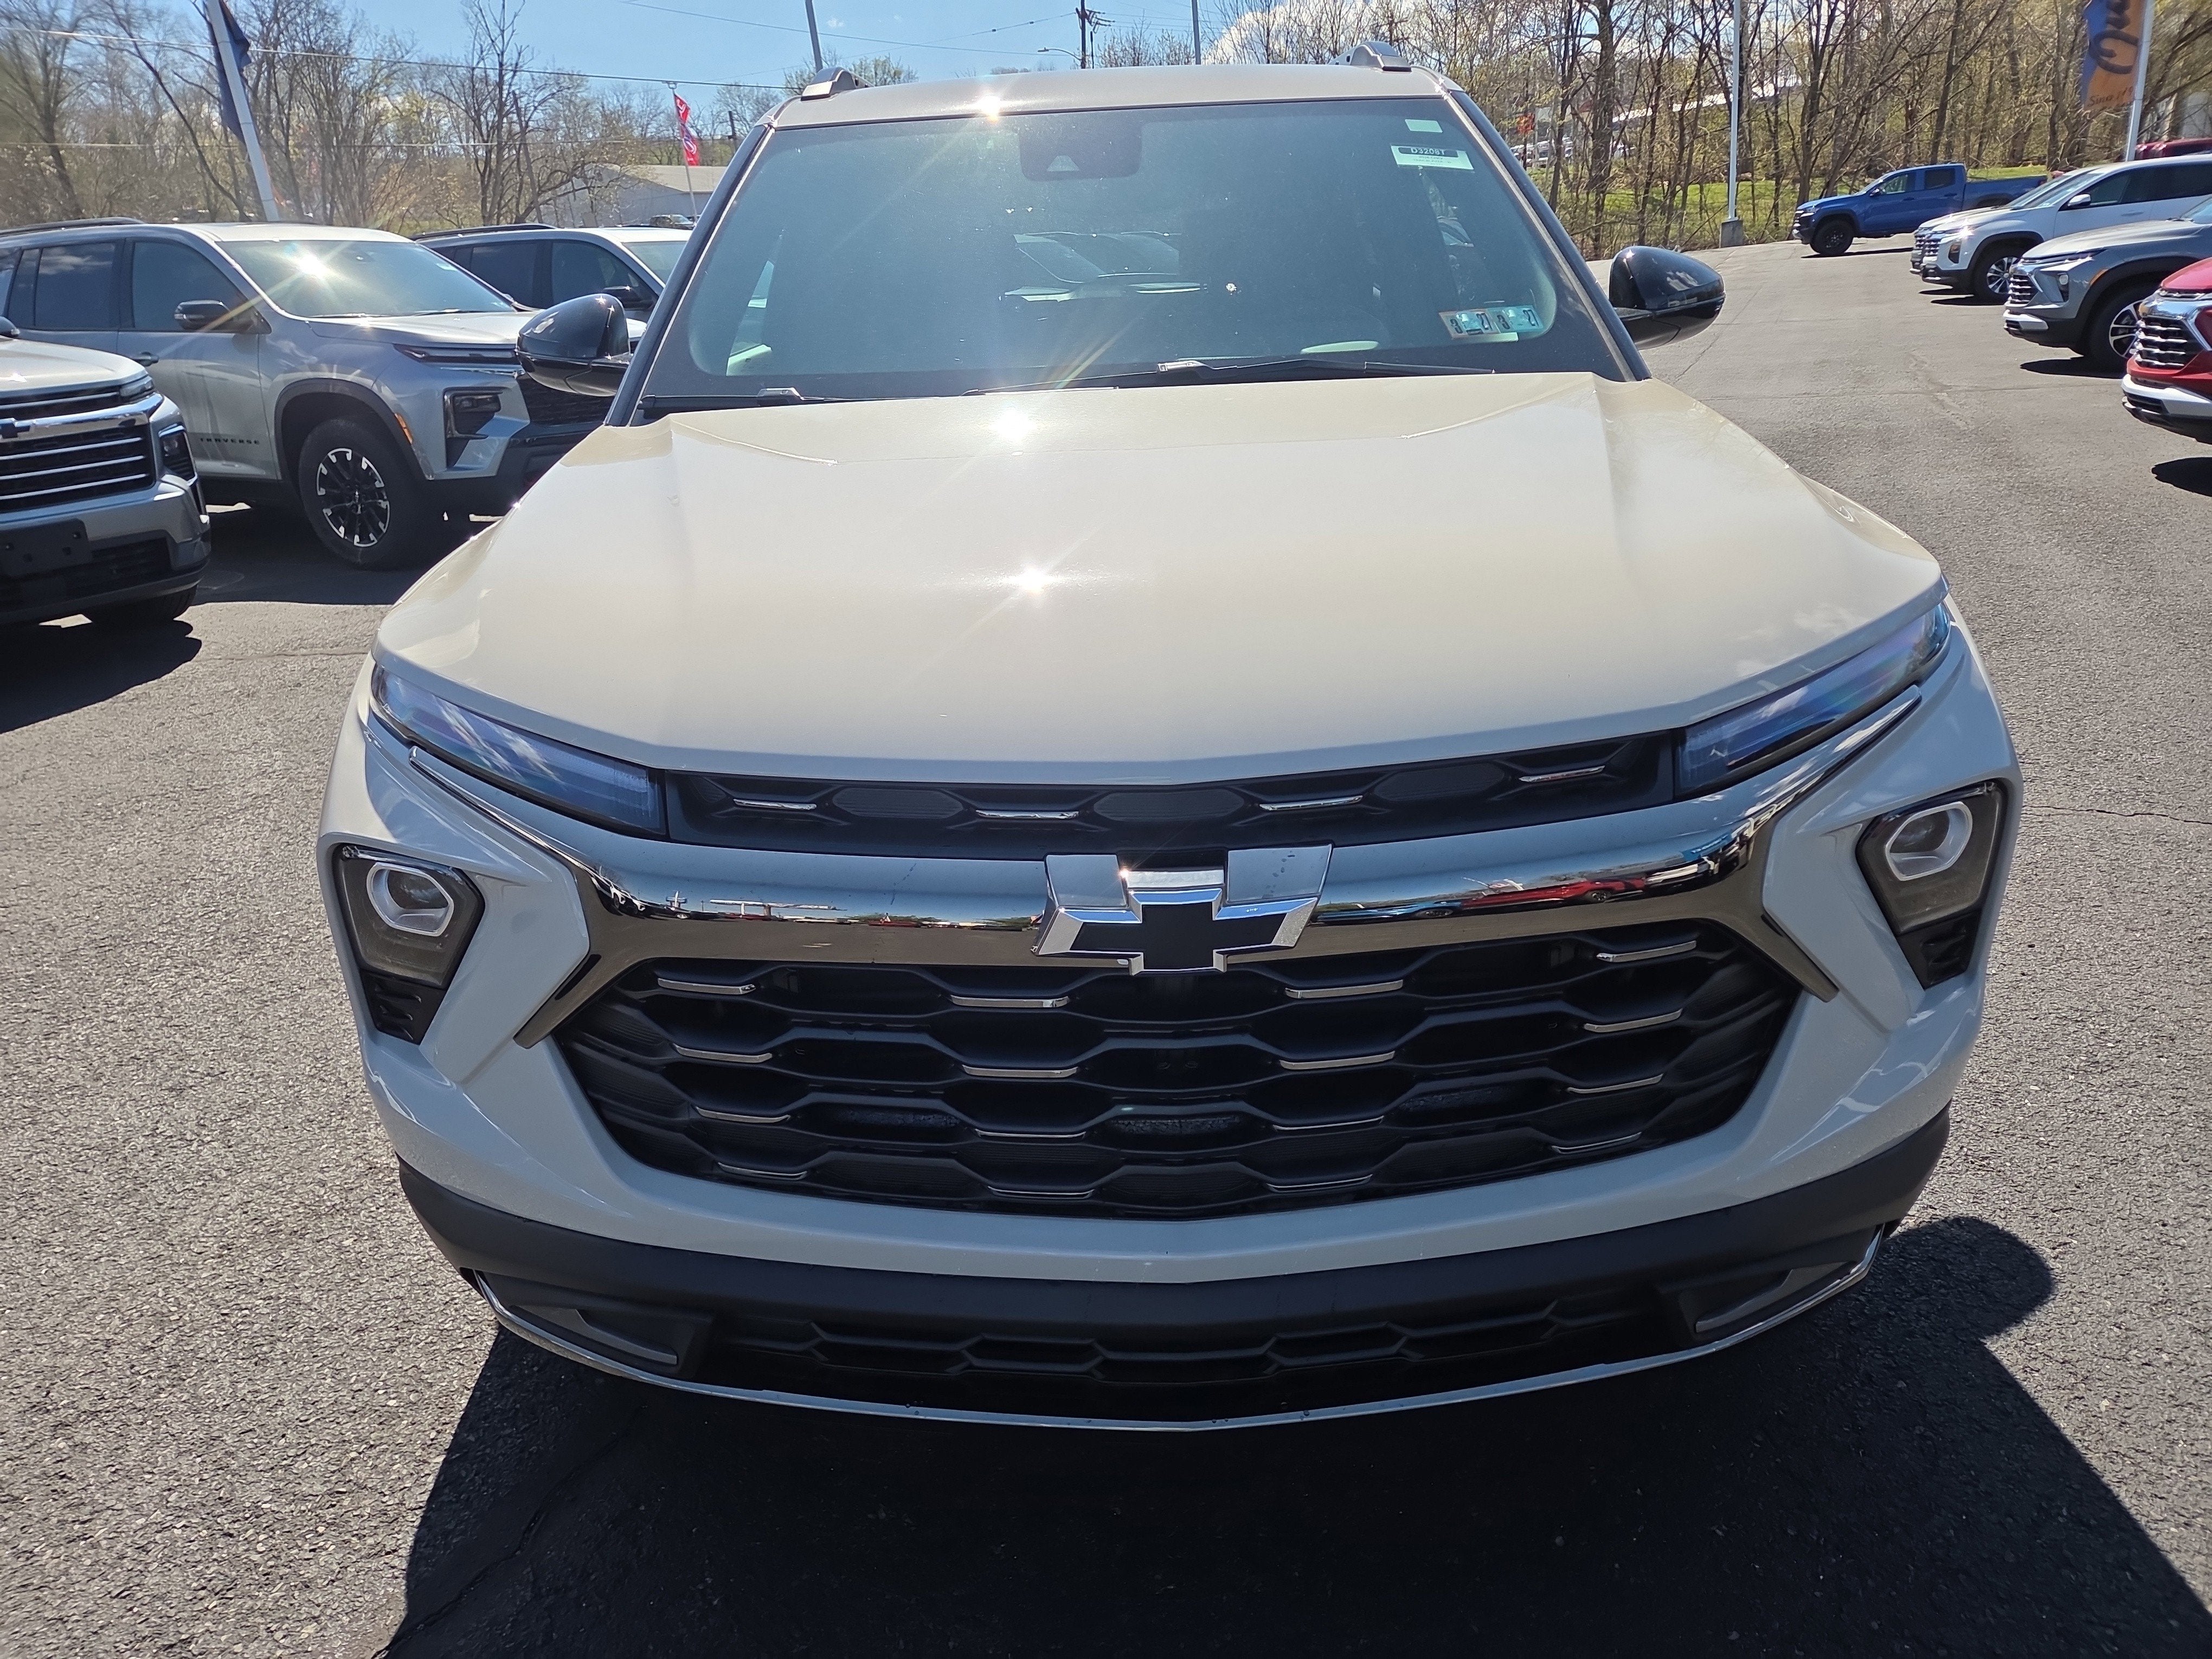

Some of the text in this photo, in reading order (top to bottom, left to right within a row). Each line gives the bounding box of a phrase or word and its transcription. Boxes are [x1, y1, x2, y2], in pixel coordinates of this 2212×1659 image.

[1450, 312, 1493, 334] 3 27
[1497, 309, 1539, 330] 3 27
